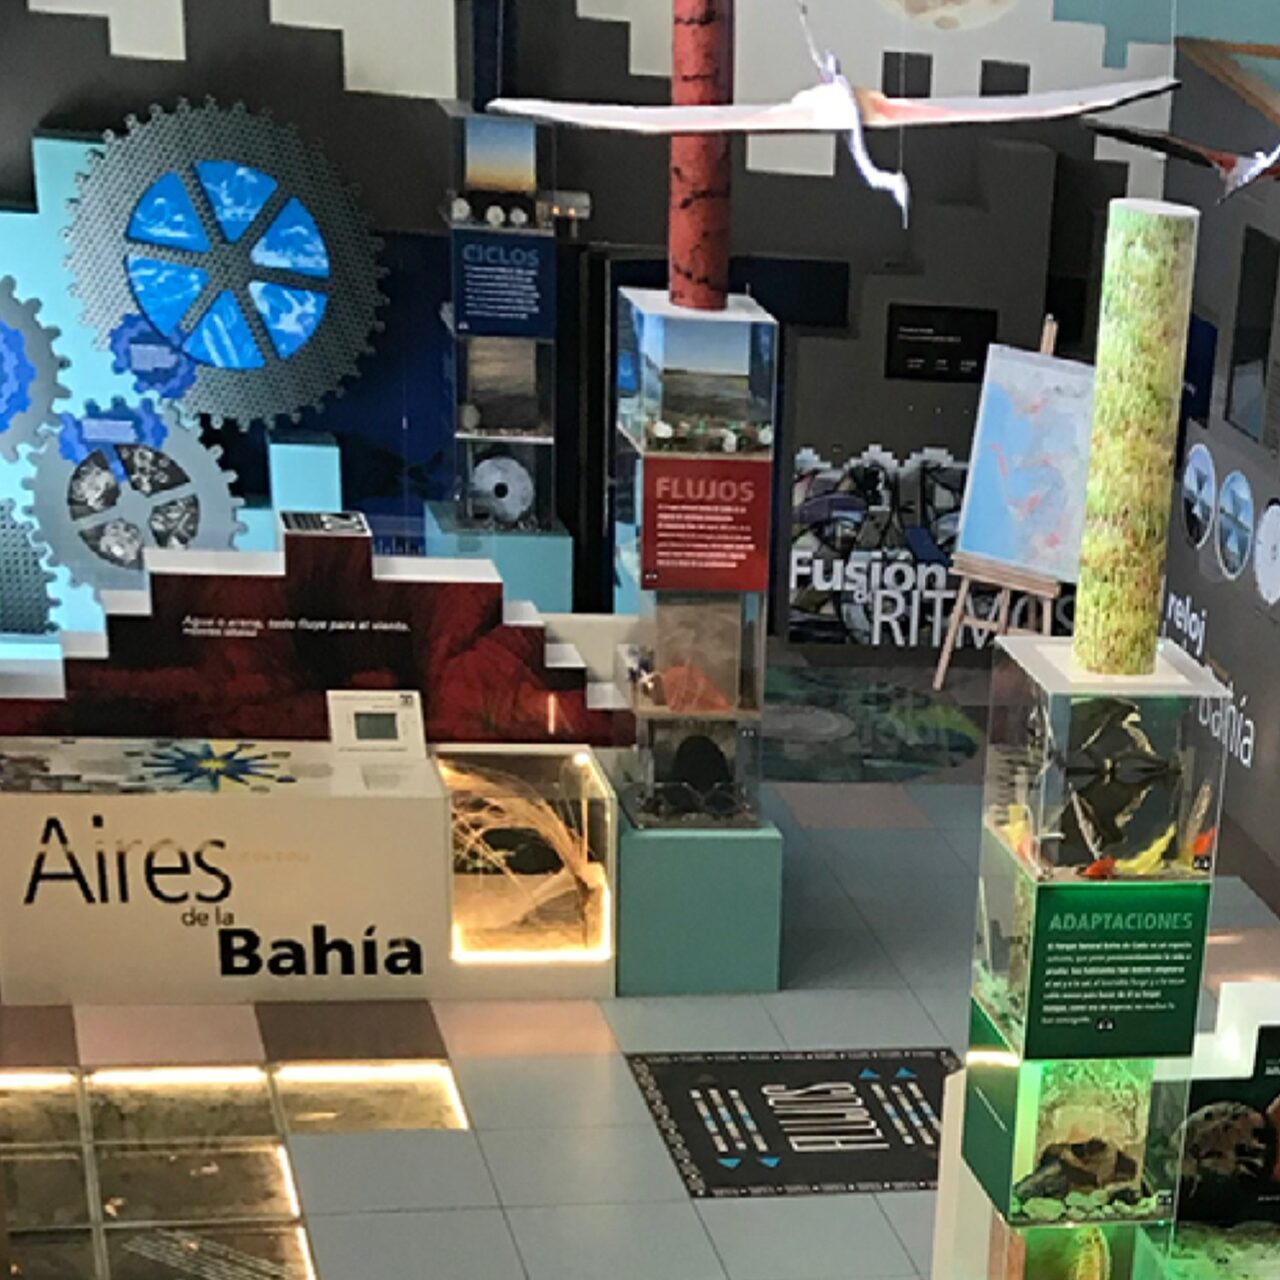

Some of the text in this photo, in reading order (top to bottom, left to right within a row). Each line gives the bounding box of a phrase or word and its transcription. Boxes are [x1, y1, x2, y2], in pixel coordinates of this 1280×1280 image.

[463, 243, 540, 267] CICLOS
[655, 477, 756, 502] FLUJOS
[1167, 591, 1208, 656] reloj
[23, 814, 234, 904] Aires
[181, 904, 235, 926] de la
[1050, 911, 1194, 931] ADAPTACIONES
[218, 925, 424, 976] Bahía
